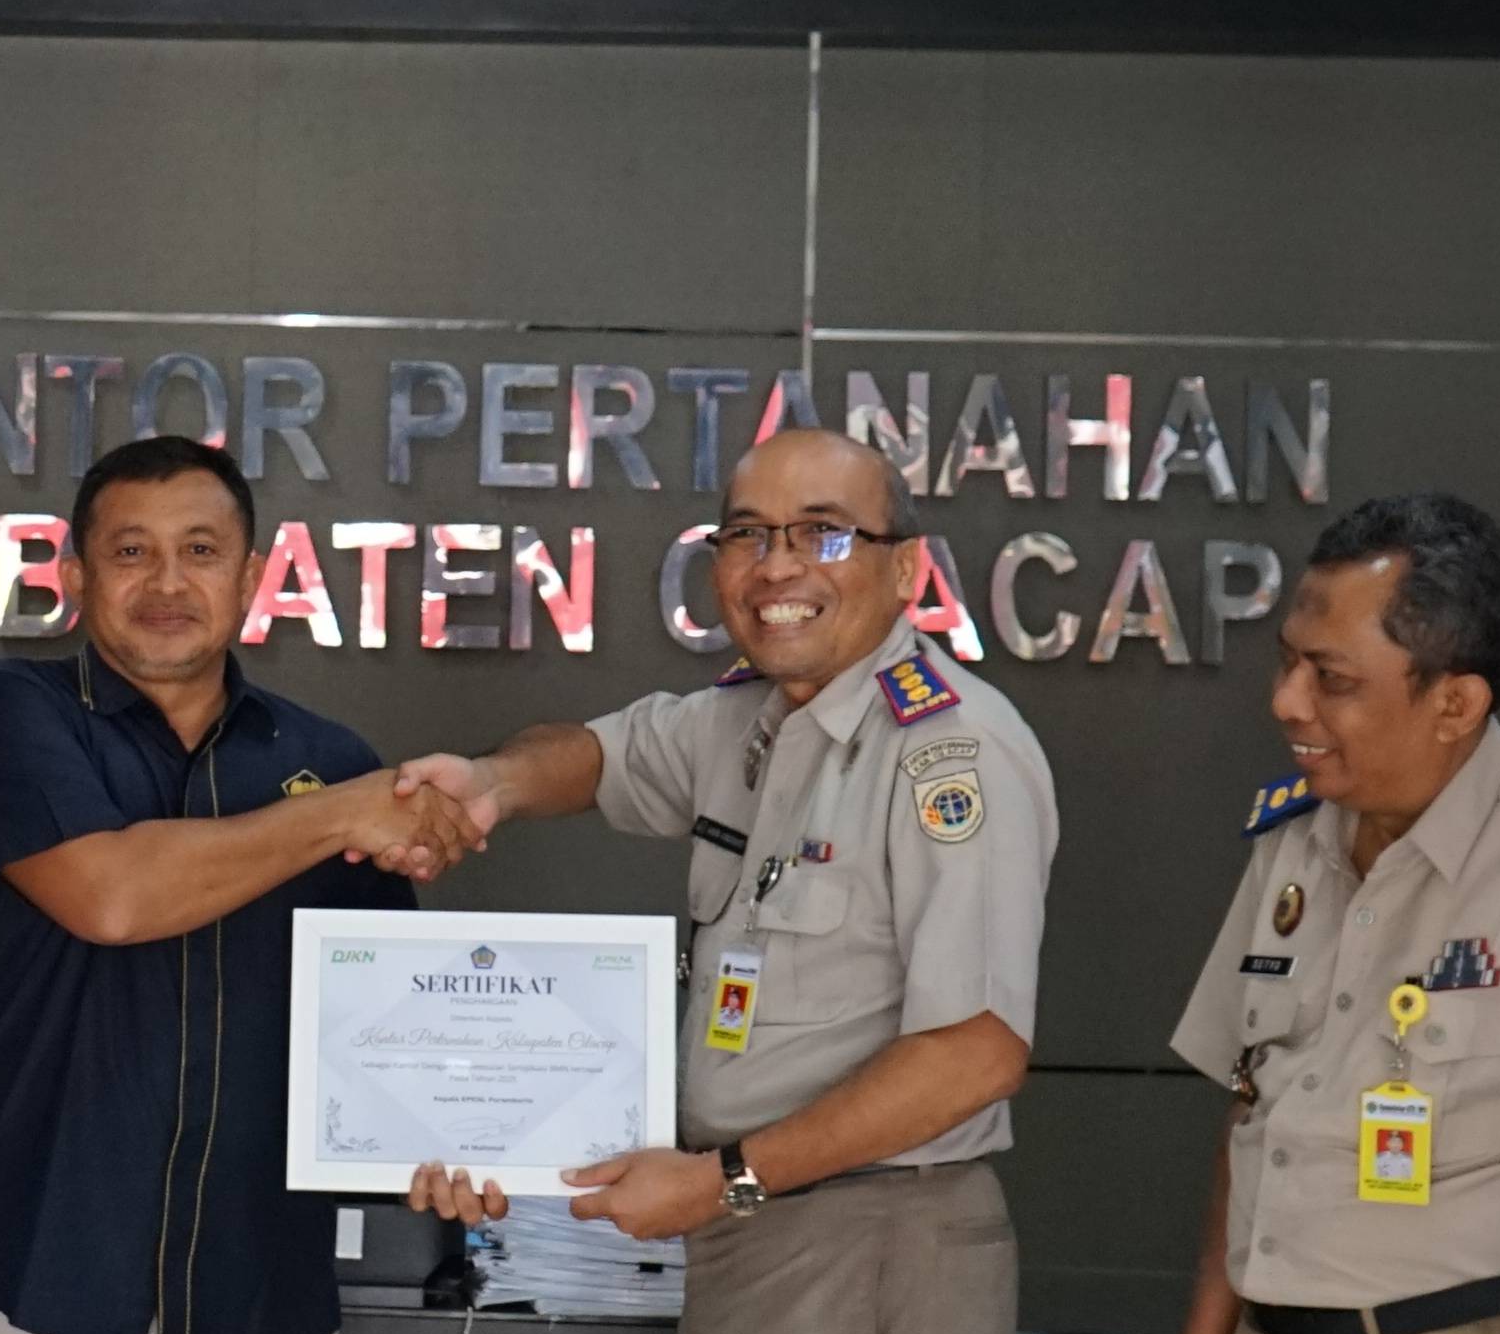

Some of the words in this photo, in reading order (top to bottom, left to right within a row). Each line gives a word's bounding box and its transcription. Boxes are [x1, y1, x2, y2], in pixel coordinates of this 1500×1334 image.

[387, 360, 1332, 504] PERTANAHAN
[659, 523, 1284, 666] CACAP
[410, 973, 559, 996] SERTIFIKAT
